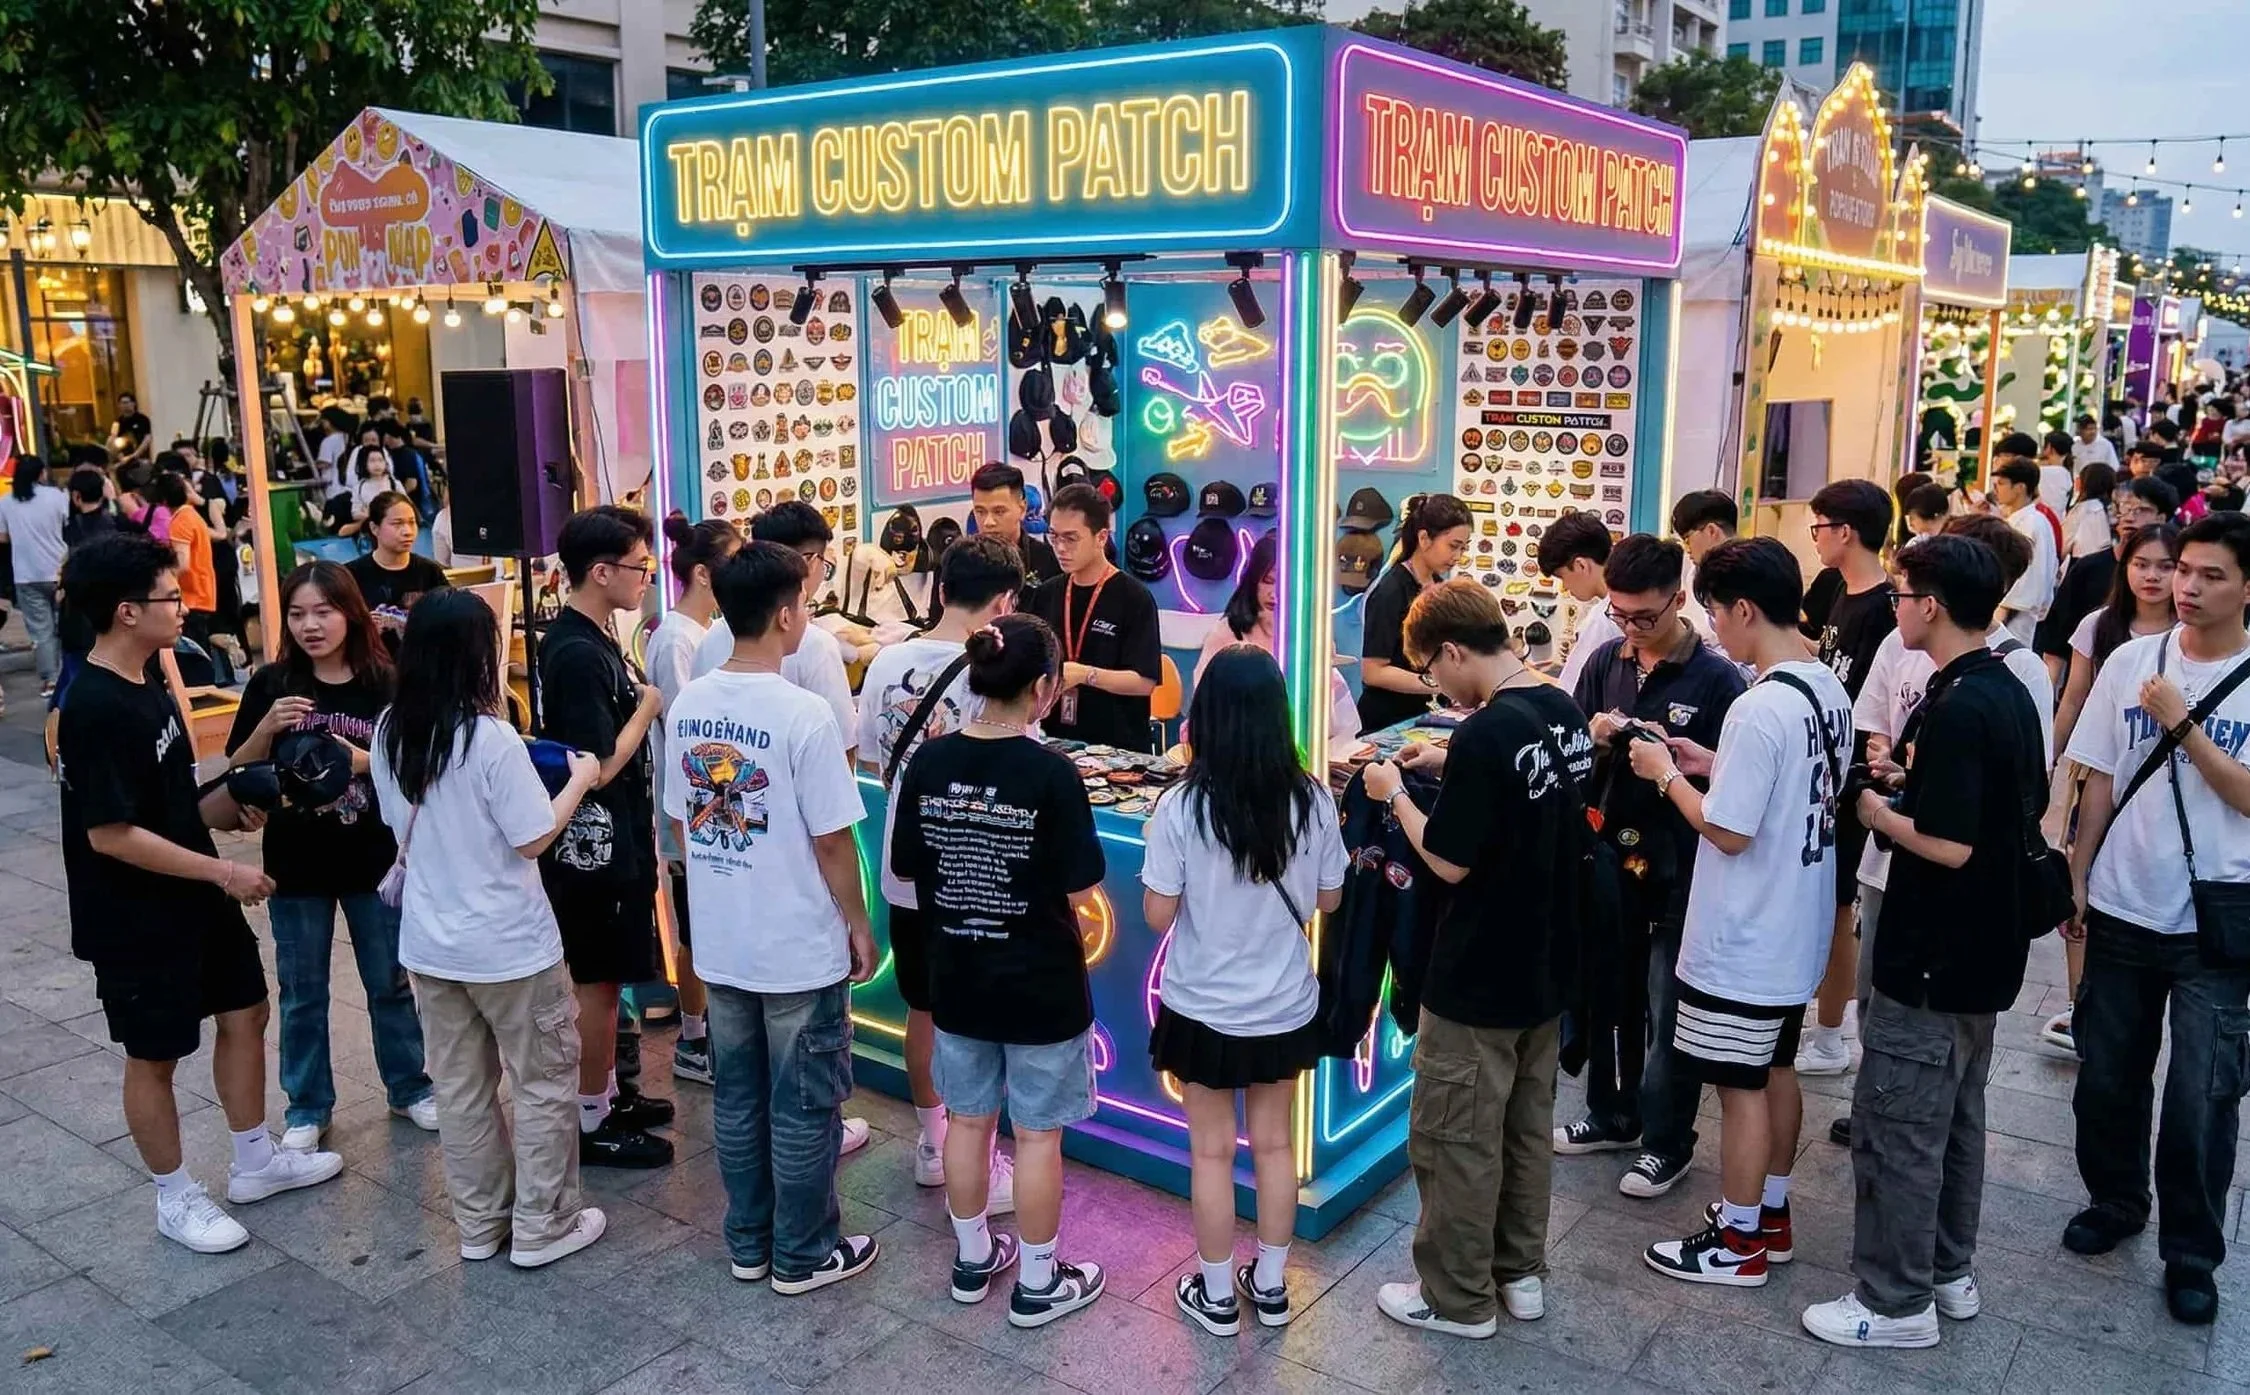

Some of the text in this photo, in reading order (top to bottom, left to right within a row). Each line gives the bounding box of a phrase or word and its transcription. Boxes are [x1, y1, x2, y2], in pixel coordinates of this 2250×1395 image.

[668, 90, 1249, 237] TRẠM CUSTOM PATCH
[1365, 94, 1676, 238] TRẠM CUSTOM PATCH
[898, 309, 980, 372] TRẠM
[876, 373, 998, 431] CUSTOM
[891, 431, 986, 491] PATCH
